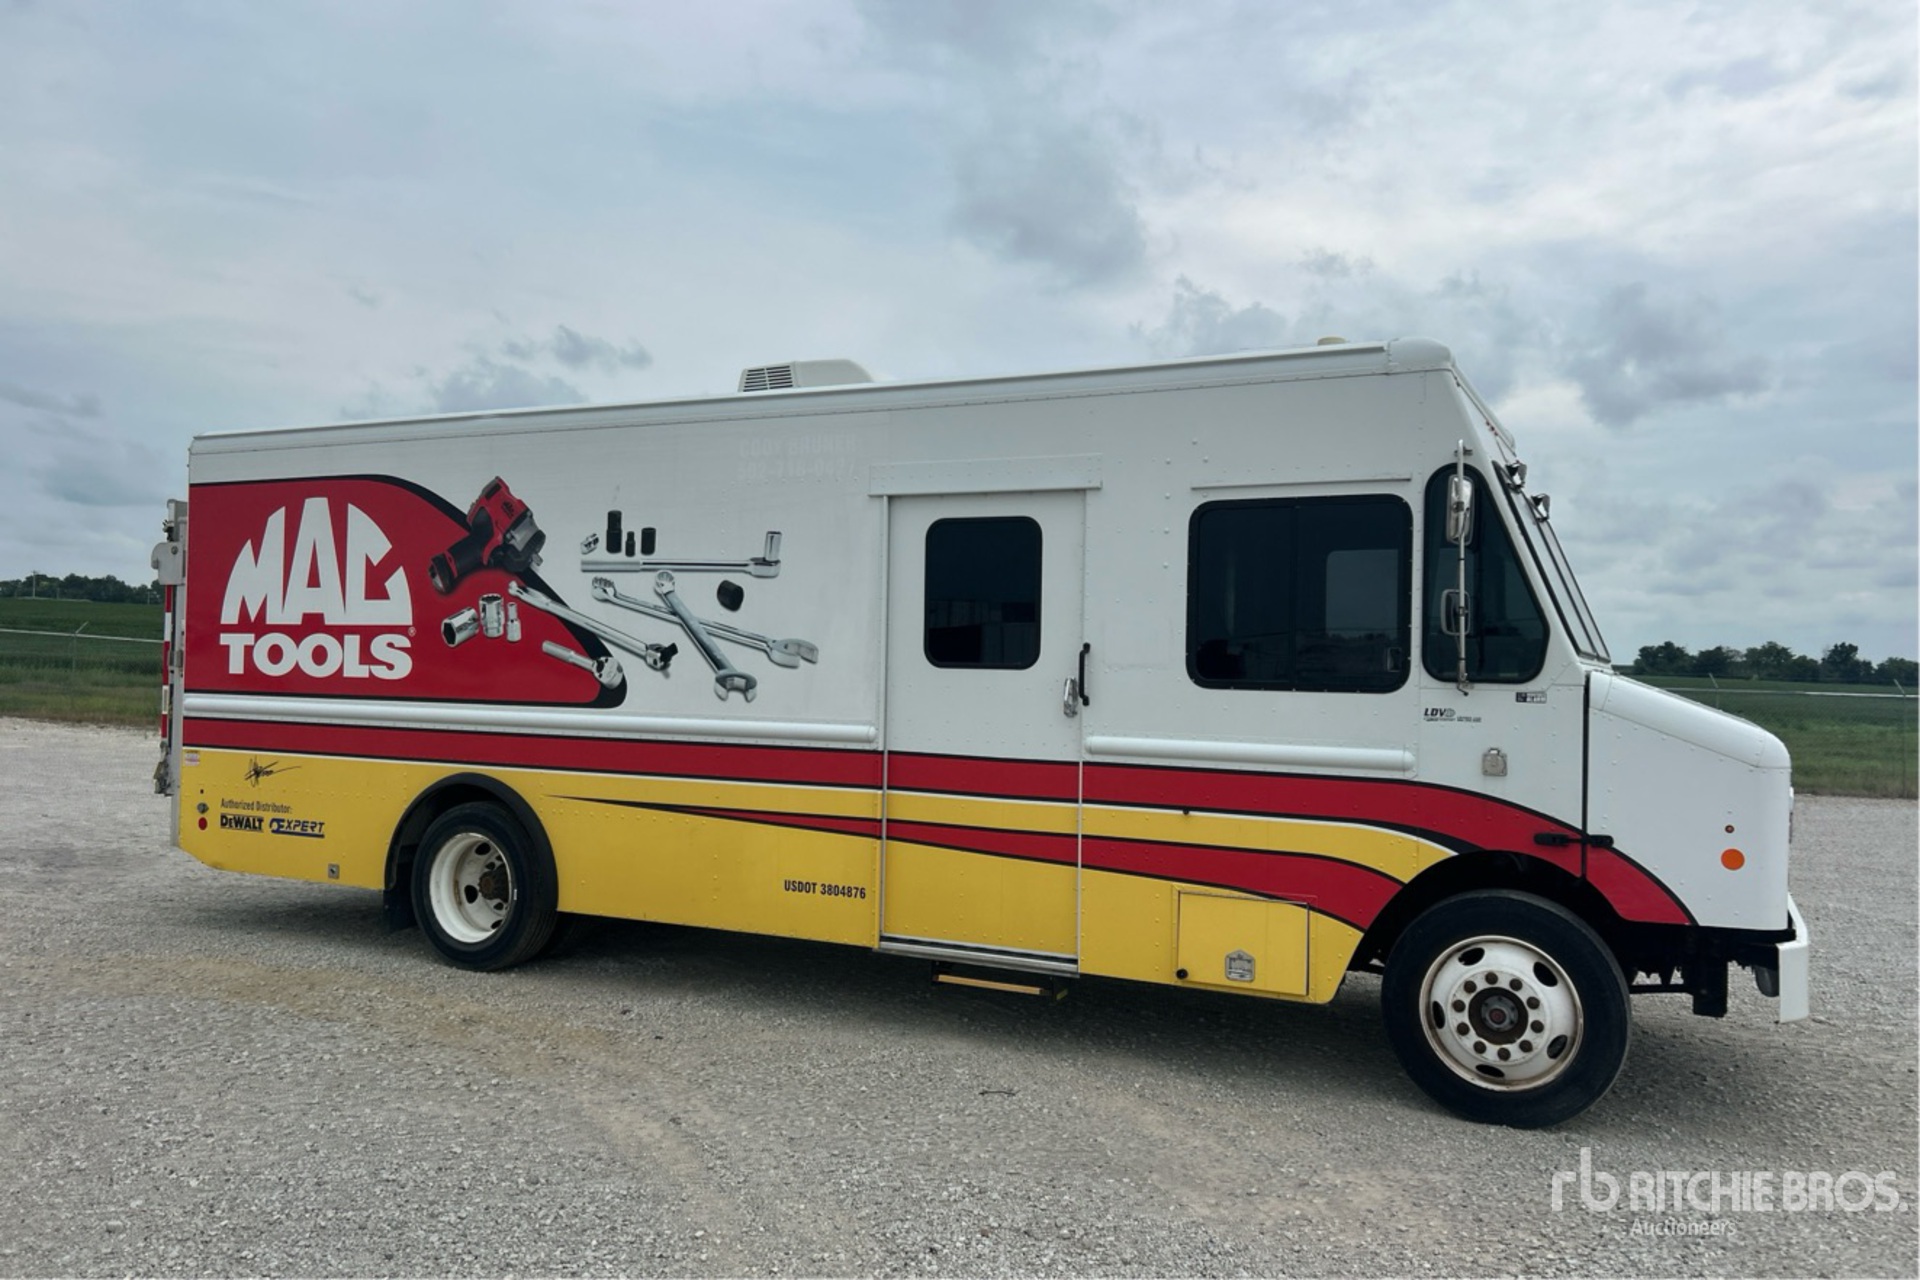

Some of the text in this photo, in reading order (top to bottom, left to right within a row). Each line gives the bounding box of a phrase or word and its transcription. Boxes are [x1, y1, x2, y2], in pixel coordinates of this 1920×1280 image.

[220, 497, 412, 626] MAC
[219, 632, 413, 680] TOOLS
[221, 798, 254, 811] Authorized
[784, 879, 866, 899] USDOT 3804876
